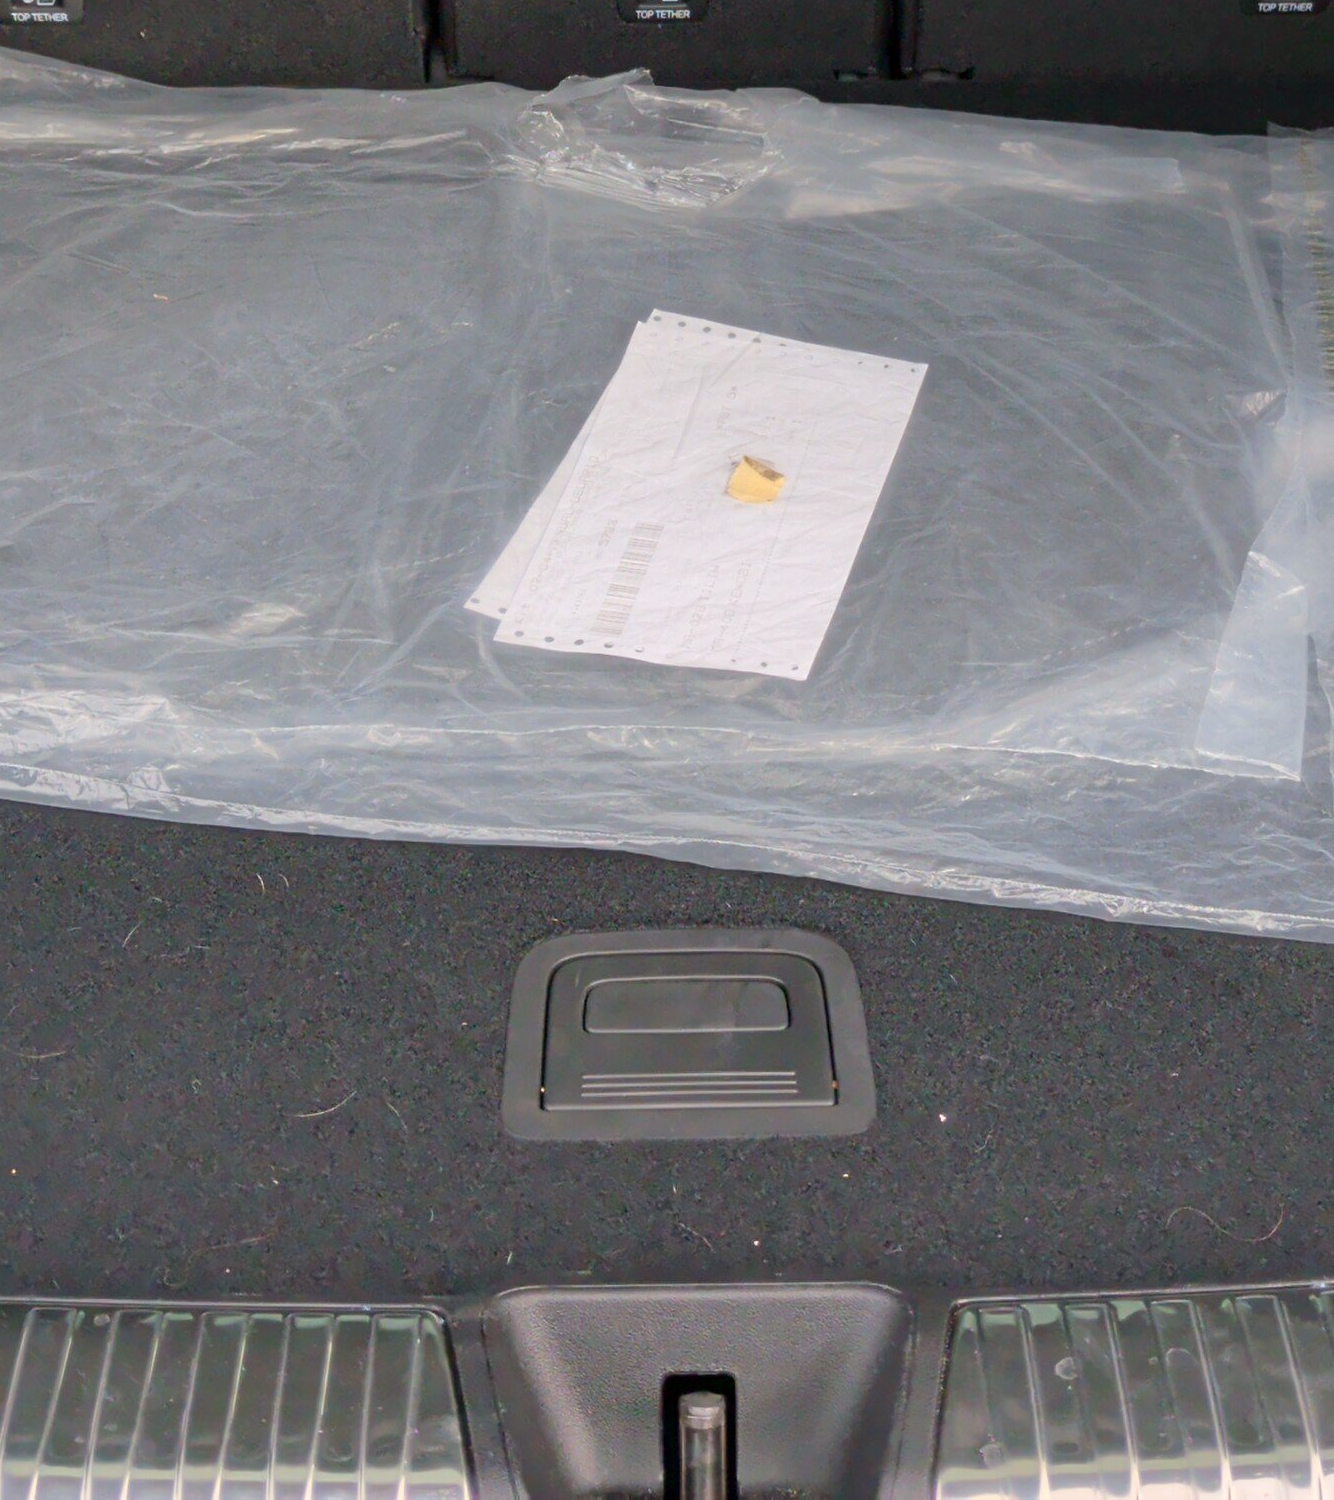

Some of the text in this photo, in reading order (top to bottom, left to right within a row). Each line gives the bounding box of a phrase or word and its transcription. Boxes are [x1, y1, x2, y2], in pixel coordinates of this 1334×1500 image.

[1257, 2, 1313, 12] TOP TETHER
[11, 13, 69, 22] TOP TETHER
[635, 10, 691, 19] TOP TETHER
